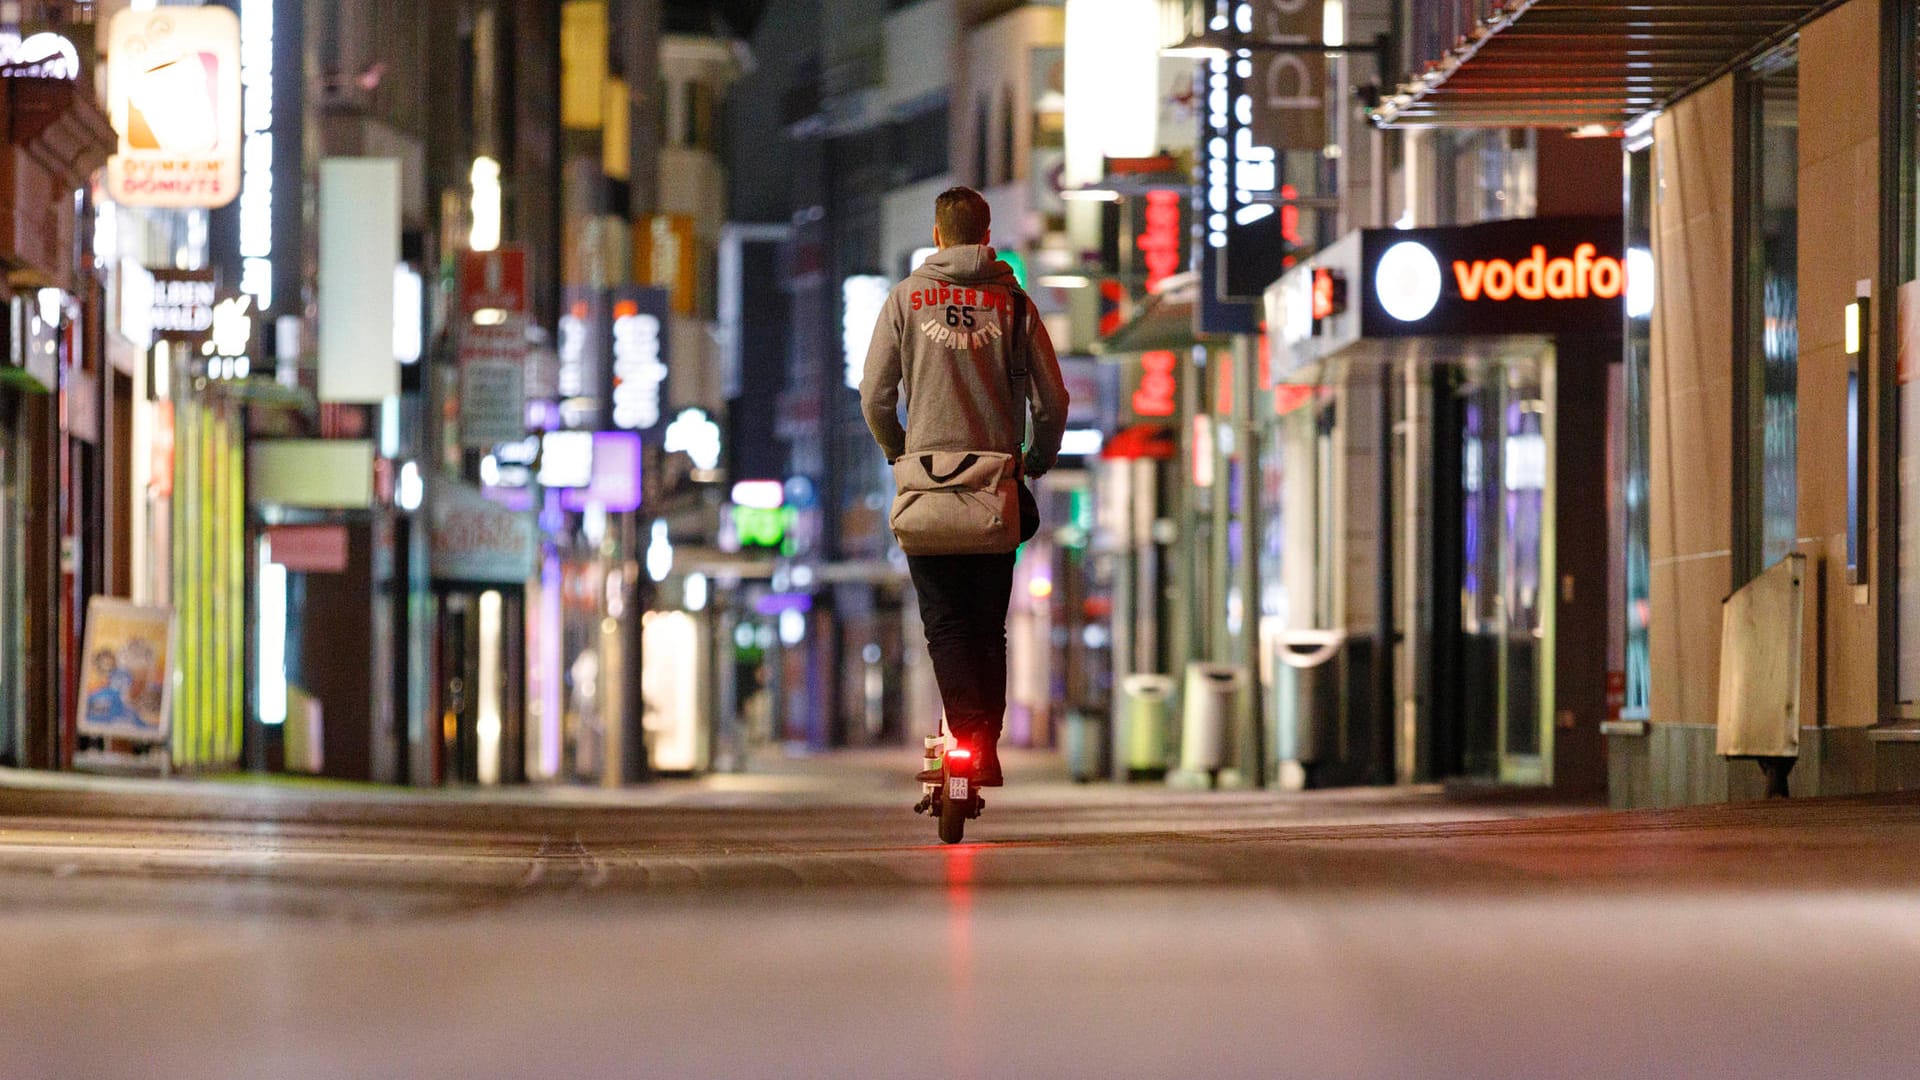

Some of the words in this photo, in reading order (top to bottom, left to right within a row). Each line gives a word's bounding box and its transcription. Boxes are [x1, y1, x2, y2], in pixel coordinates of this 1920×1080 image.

[911, 288, 977, 311] SUPER
[945, 305, 976, 328] 65
[920, 318, 968, 350] JAPAN
